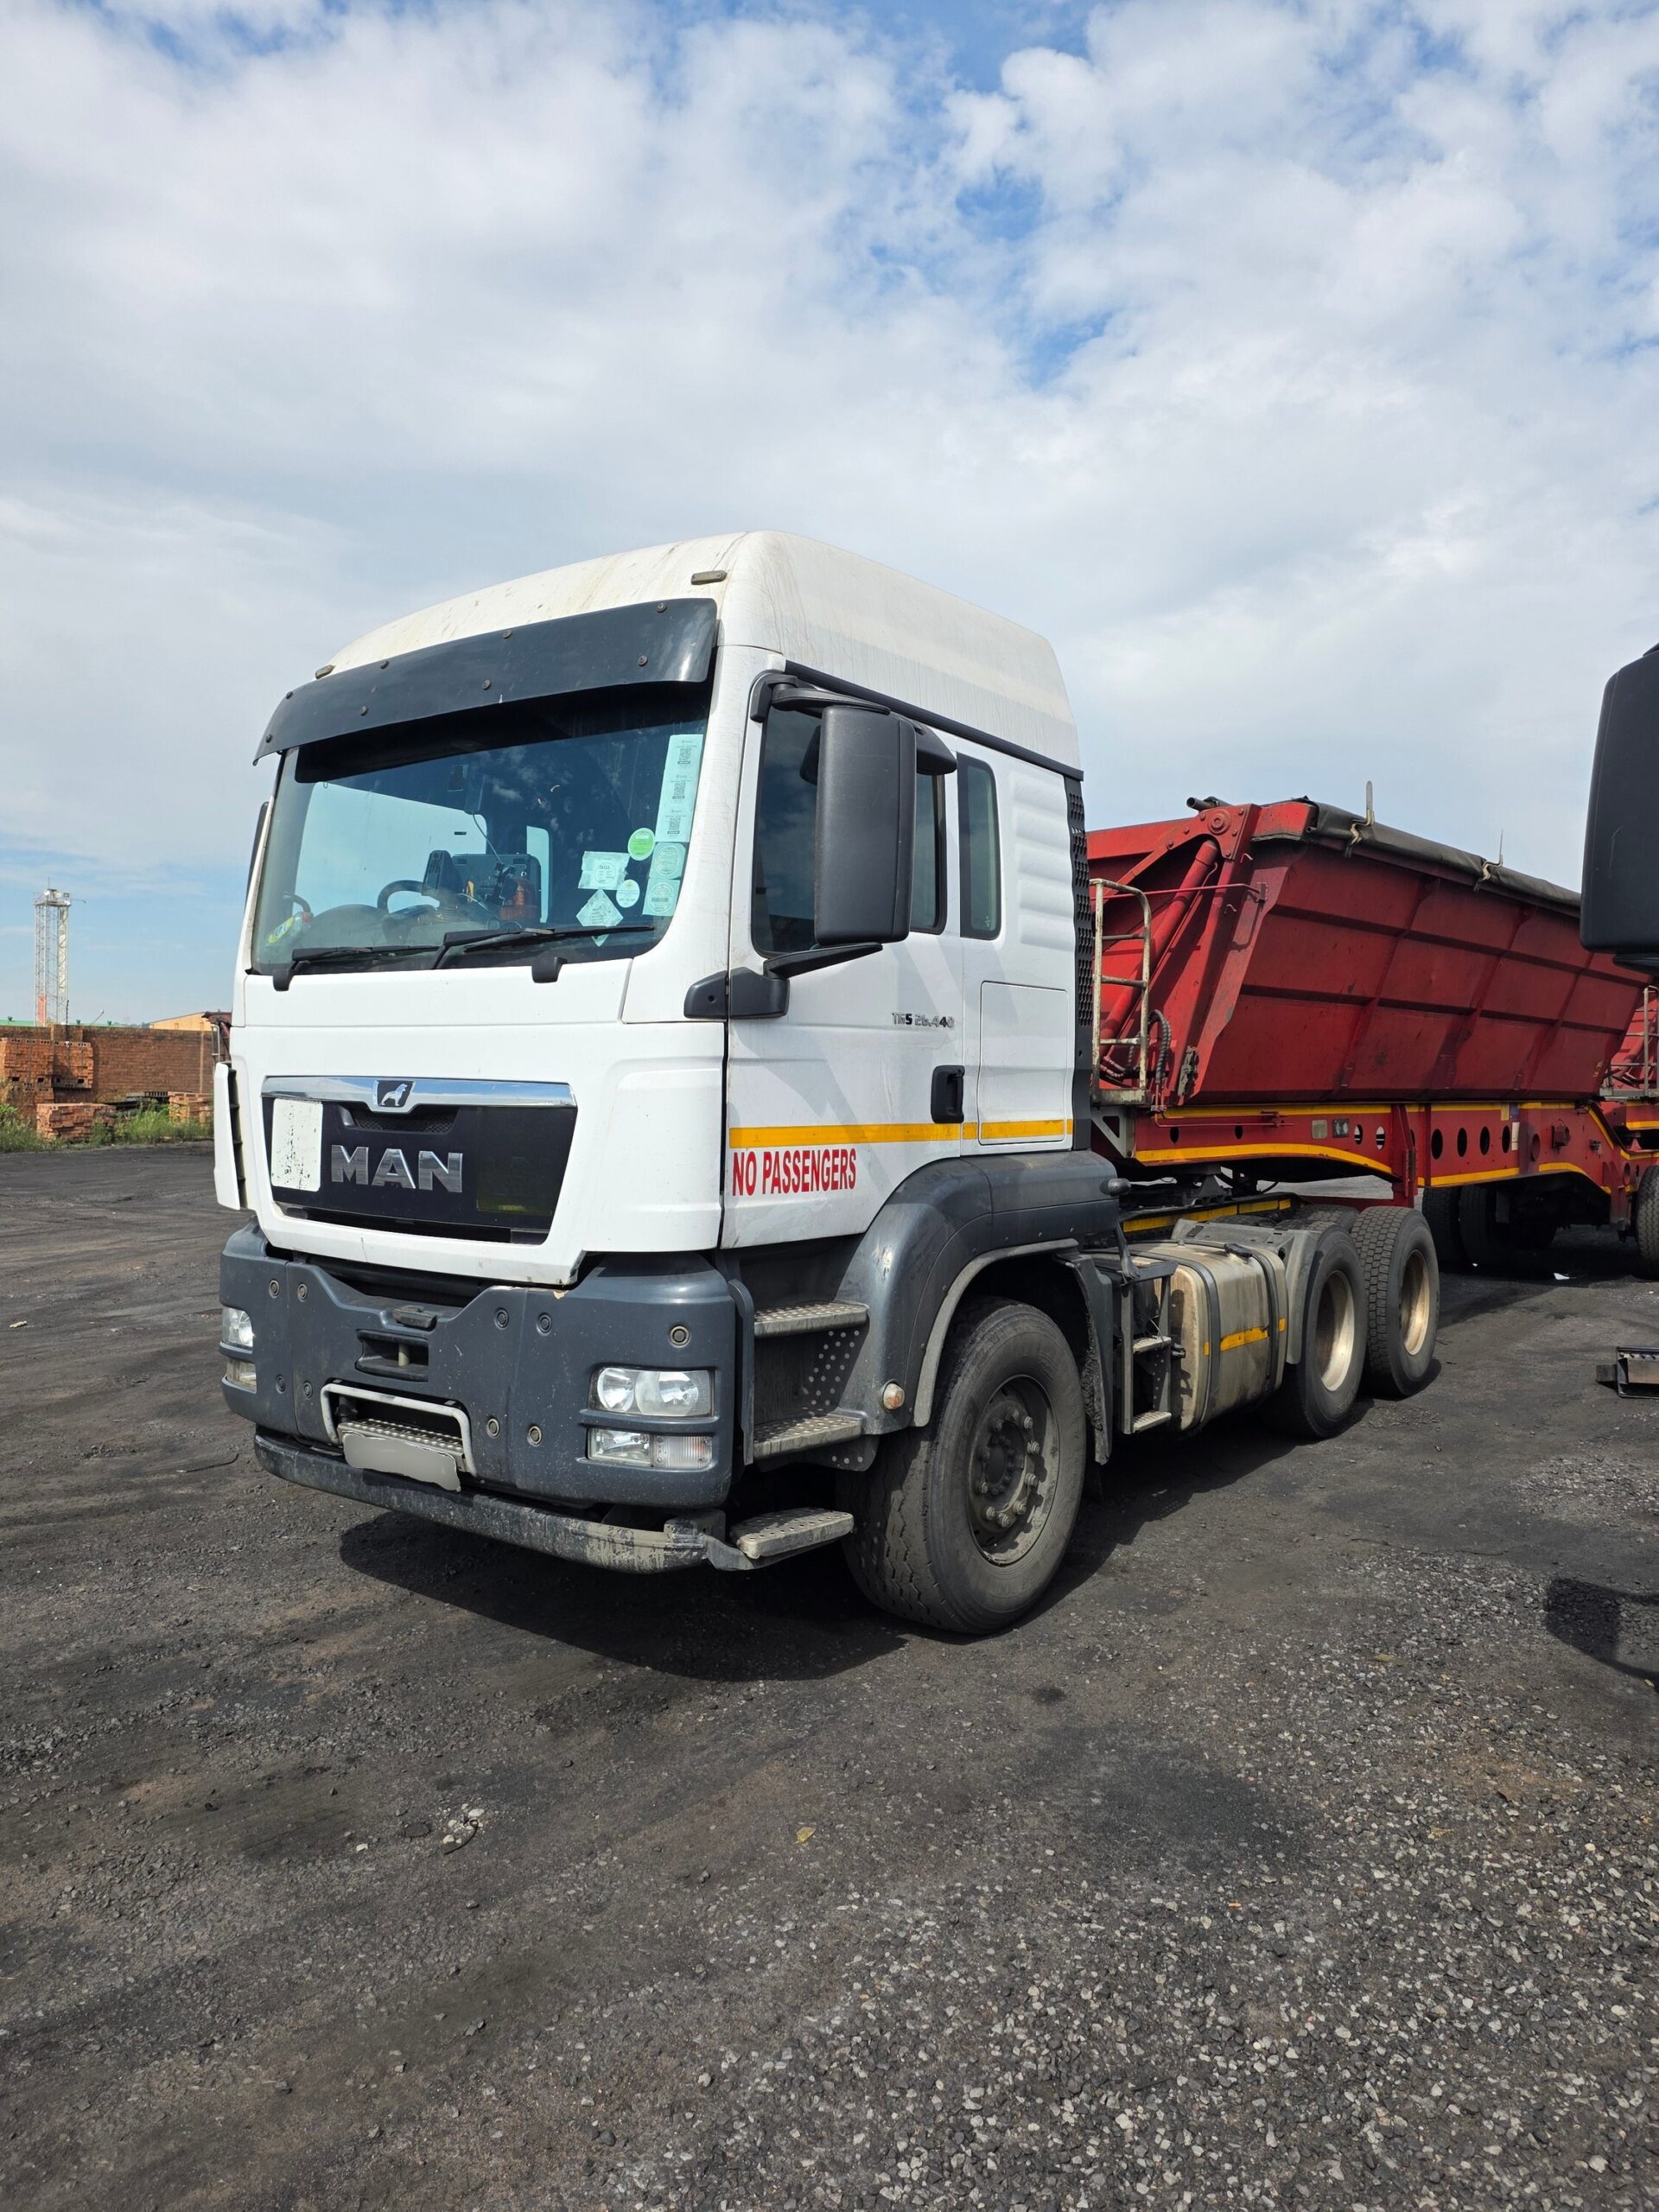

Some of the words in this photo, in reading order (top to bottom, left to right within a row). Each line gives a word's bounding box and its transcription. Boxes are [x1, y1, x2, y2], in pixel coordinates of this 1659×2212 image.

[892, 1013, 912, 1026] TGS
[914, 1014, 955, 1028] 26.440
[331, 1144, 463, 1193] MAN
[732, 1151, 757, 1196] NO
[762, 1147, 856, 1194] PASSENGERS
